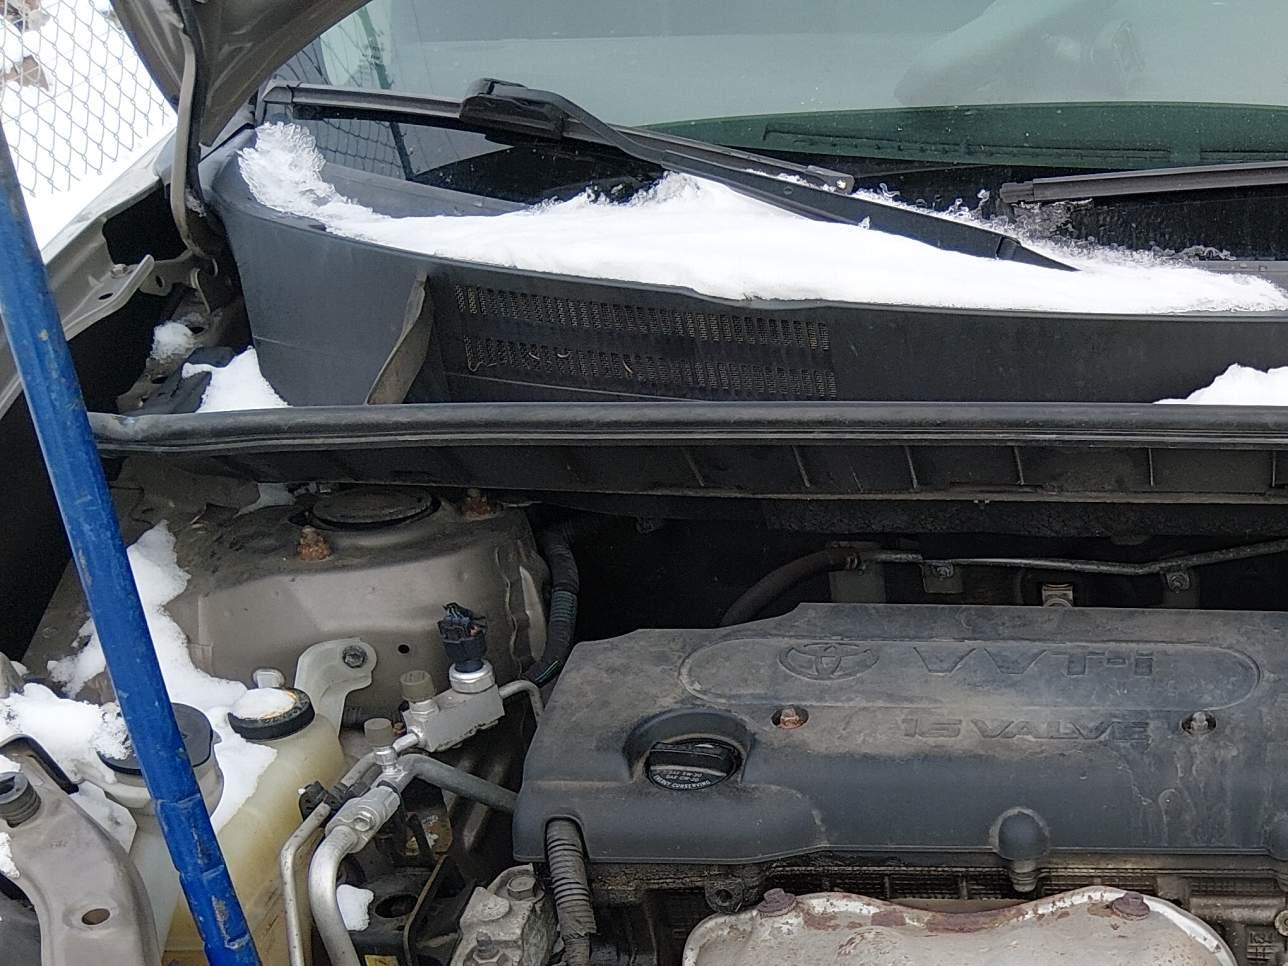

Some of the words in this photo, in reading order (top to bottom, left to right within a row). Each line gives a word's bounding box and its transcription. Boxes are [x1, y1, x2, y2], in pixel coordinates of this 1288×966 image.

[913, 647, 1154, 678] VVT-i
[901, 717, 963, 738] 16
[971, 717, 1151, 741] VALVE
[672, 780, 711, 789] CONSERVING
